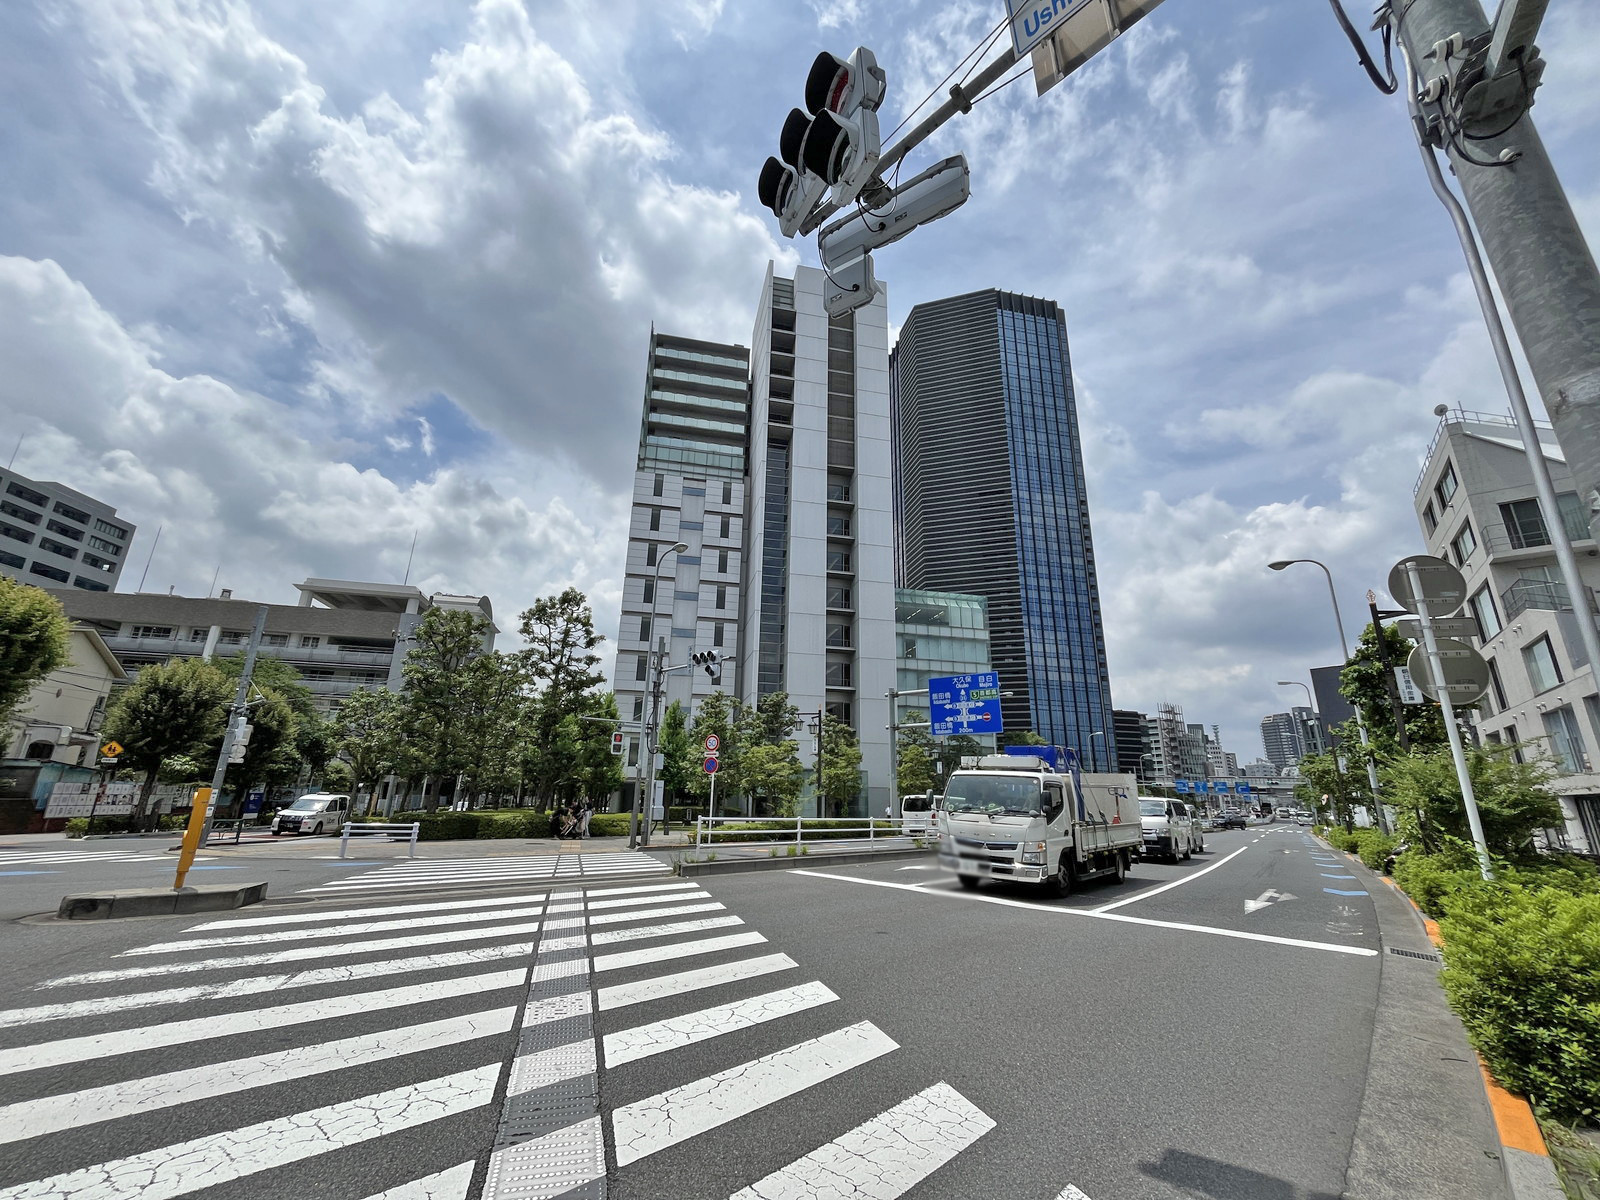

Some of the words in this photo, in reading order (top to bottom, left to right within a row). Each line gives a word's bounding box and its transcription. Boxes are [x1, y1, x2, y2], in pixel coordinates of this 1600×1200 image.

[1024, 0, 1073, 37] Ush
[952, 676, 972, 684] 大久保
[708, 739, 716, 747] 50
